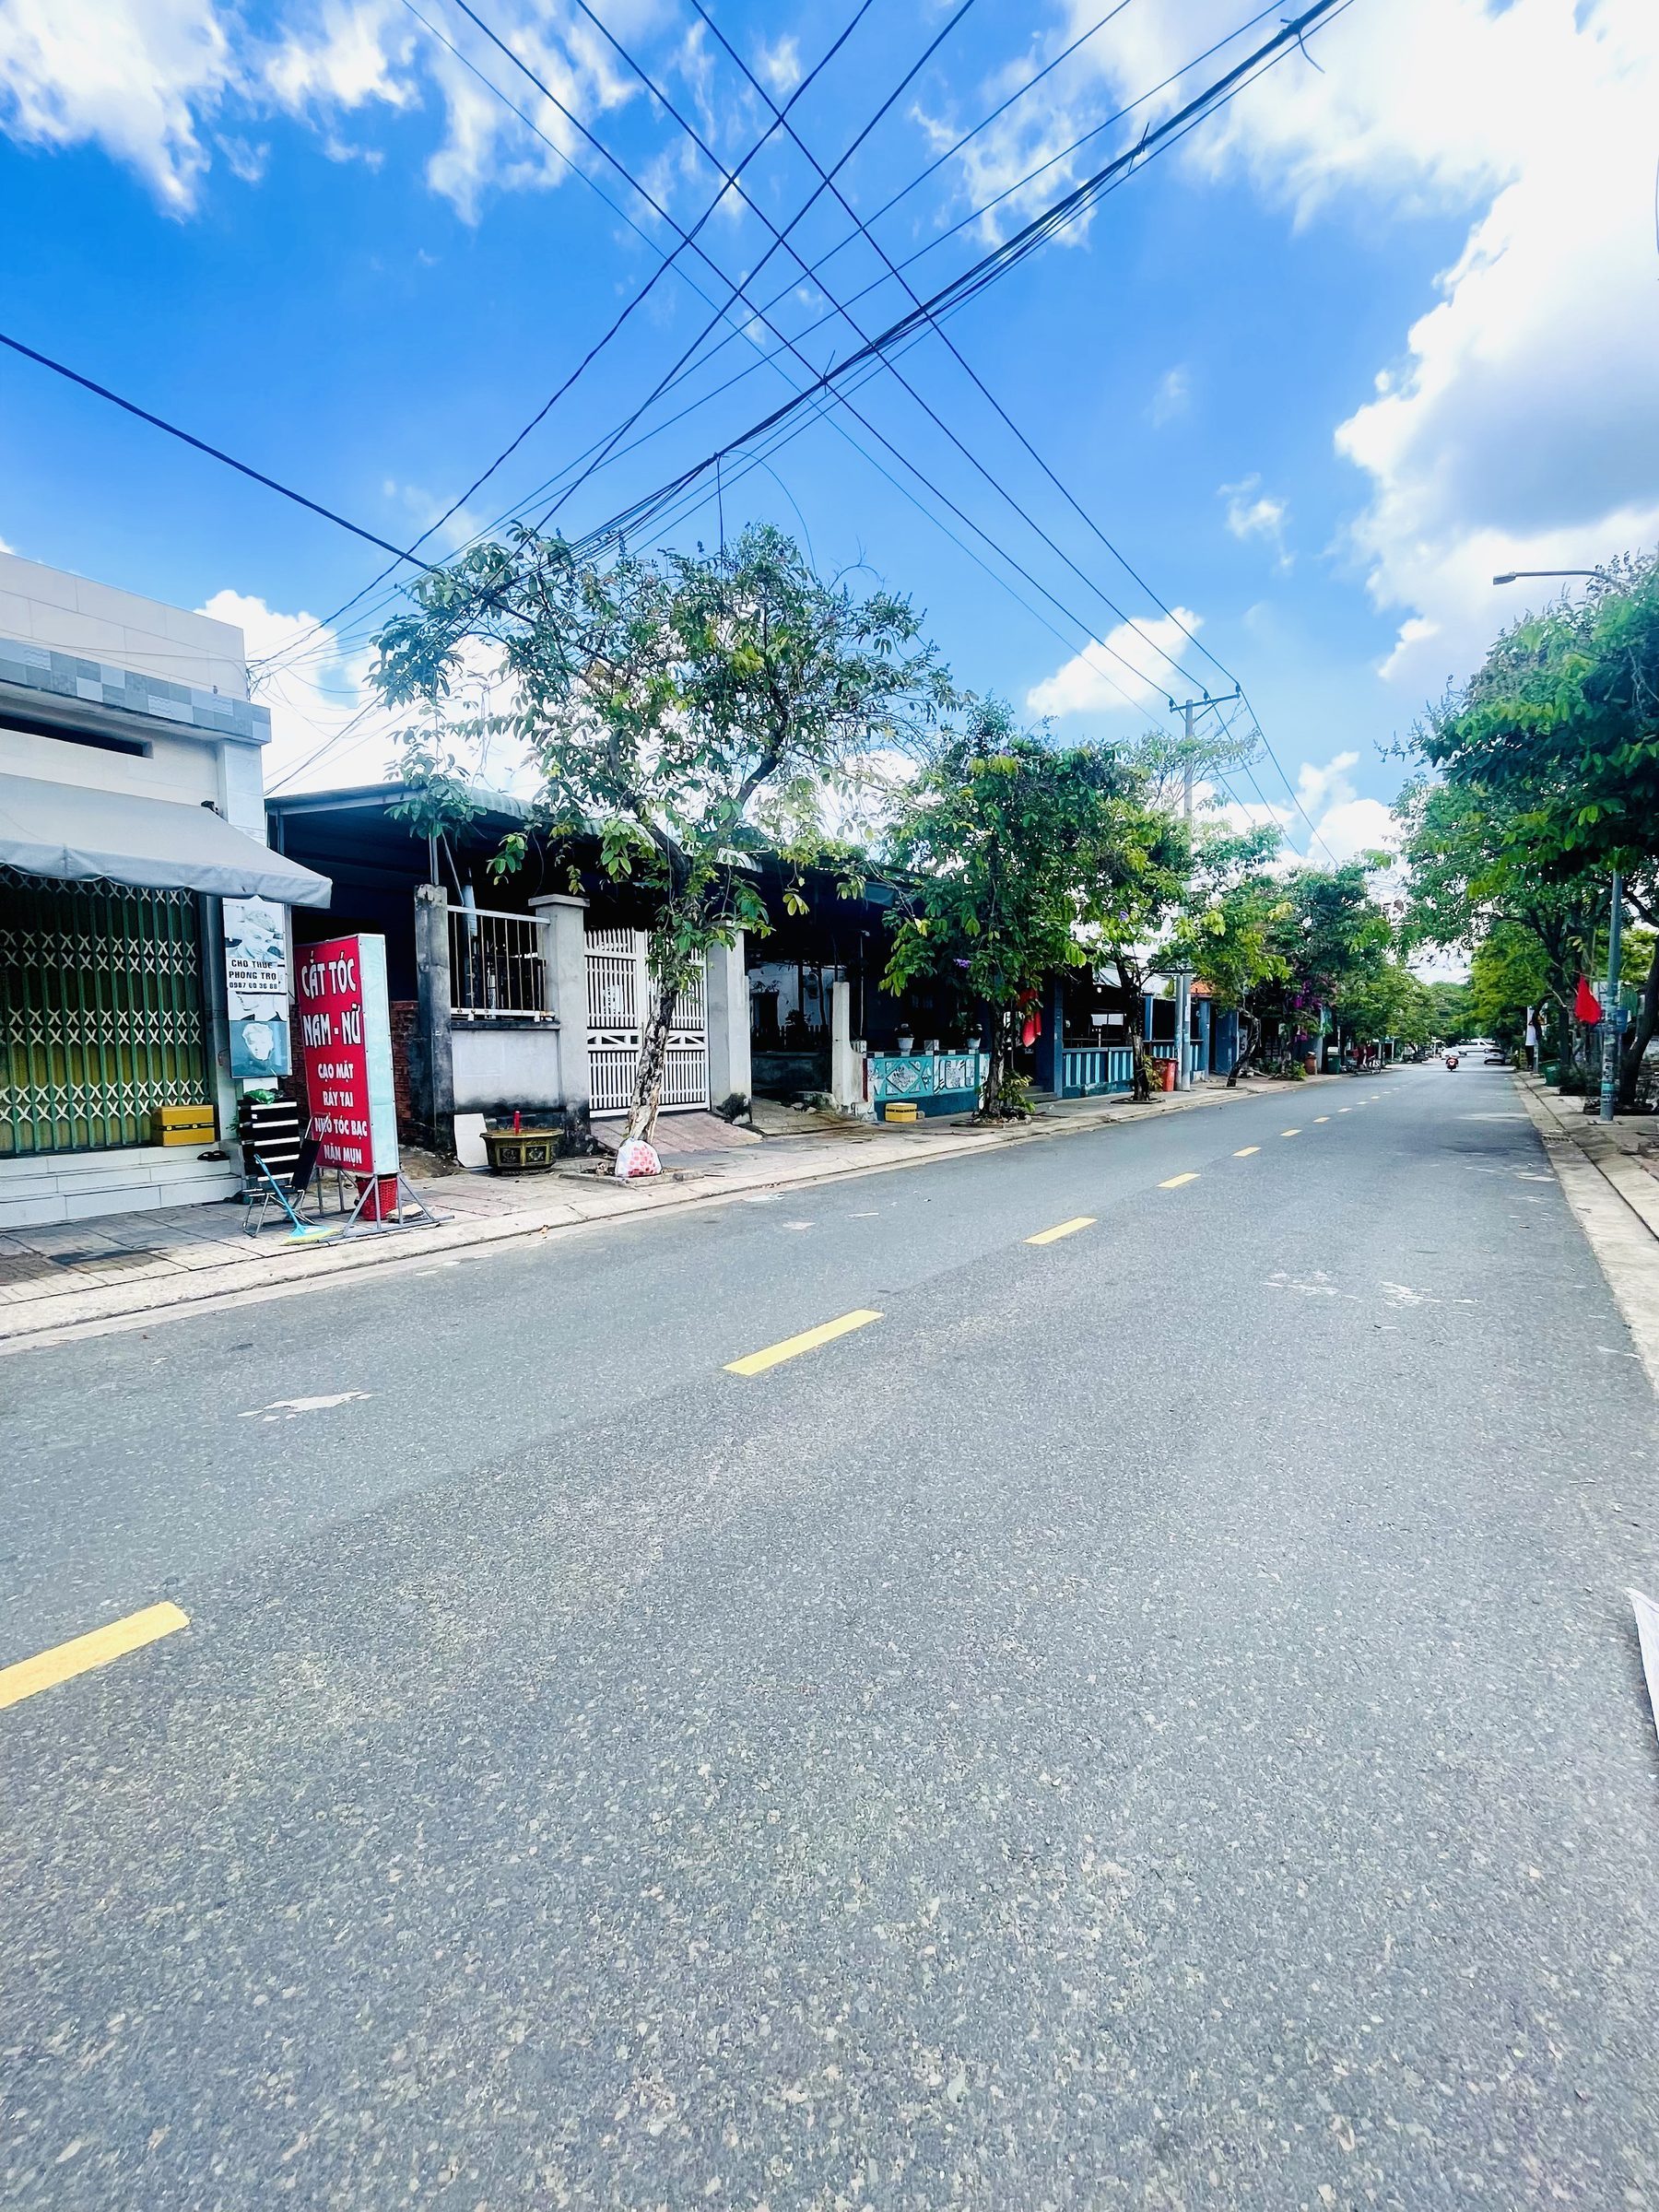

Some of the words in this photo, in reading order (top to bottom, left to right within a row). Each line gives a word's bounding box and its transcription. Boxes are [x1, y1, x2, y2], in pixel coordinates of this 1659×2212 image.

[231, 959, 249, 968] CHO
[301, 950, 325, 1000] CẮT
[328, 951, 356, 994] TÓC
[302, 1013, 332, 1049] NAM
[341, 1003, 361, 1045] NỮ
[317, 1063, 335, 1082] CẠO
[335, 1060, 354, 1083] MẶT
[323, 1087, 338, 1107] RÁY
[339, 1090, 354, 1108] TAI
[333, 1114, 350, 1135] TÓC
[351, 1120, 368, 1140] BẠC
[324, 1143, 342, 1164] NẶN
[343, 1147, 362, 1167] MỤN
